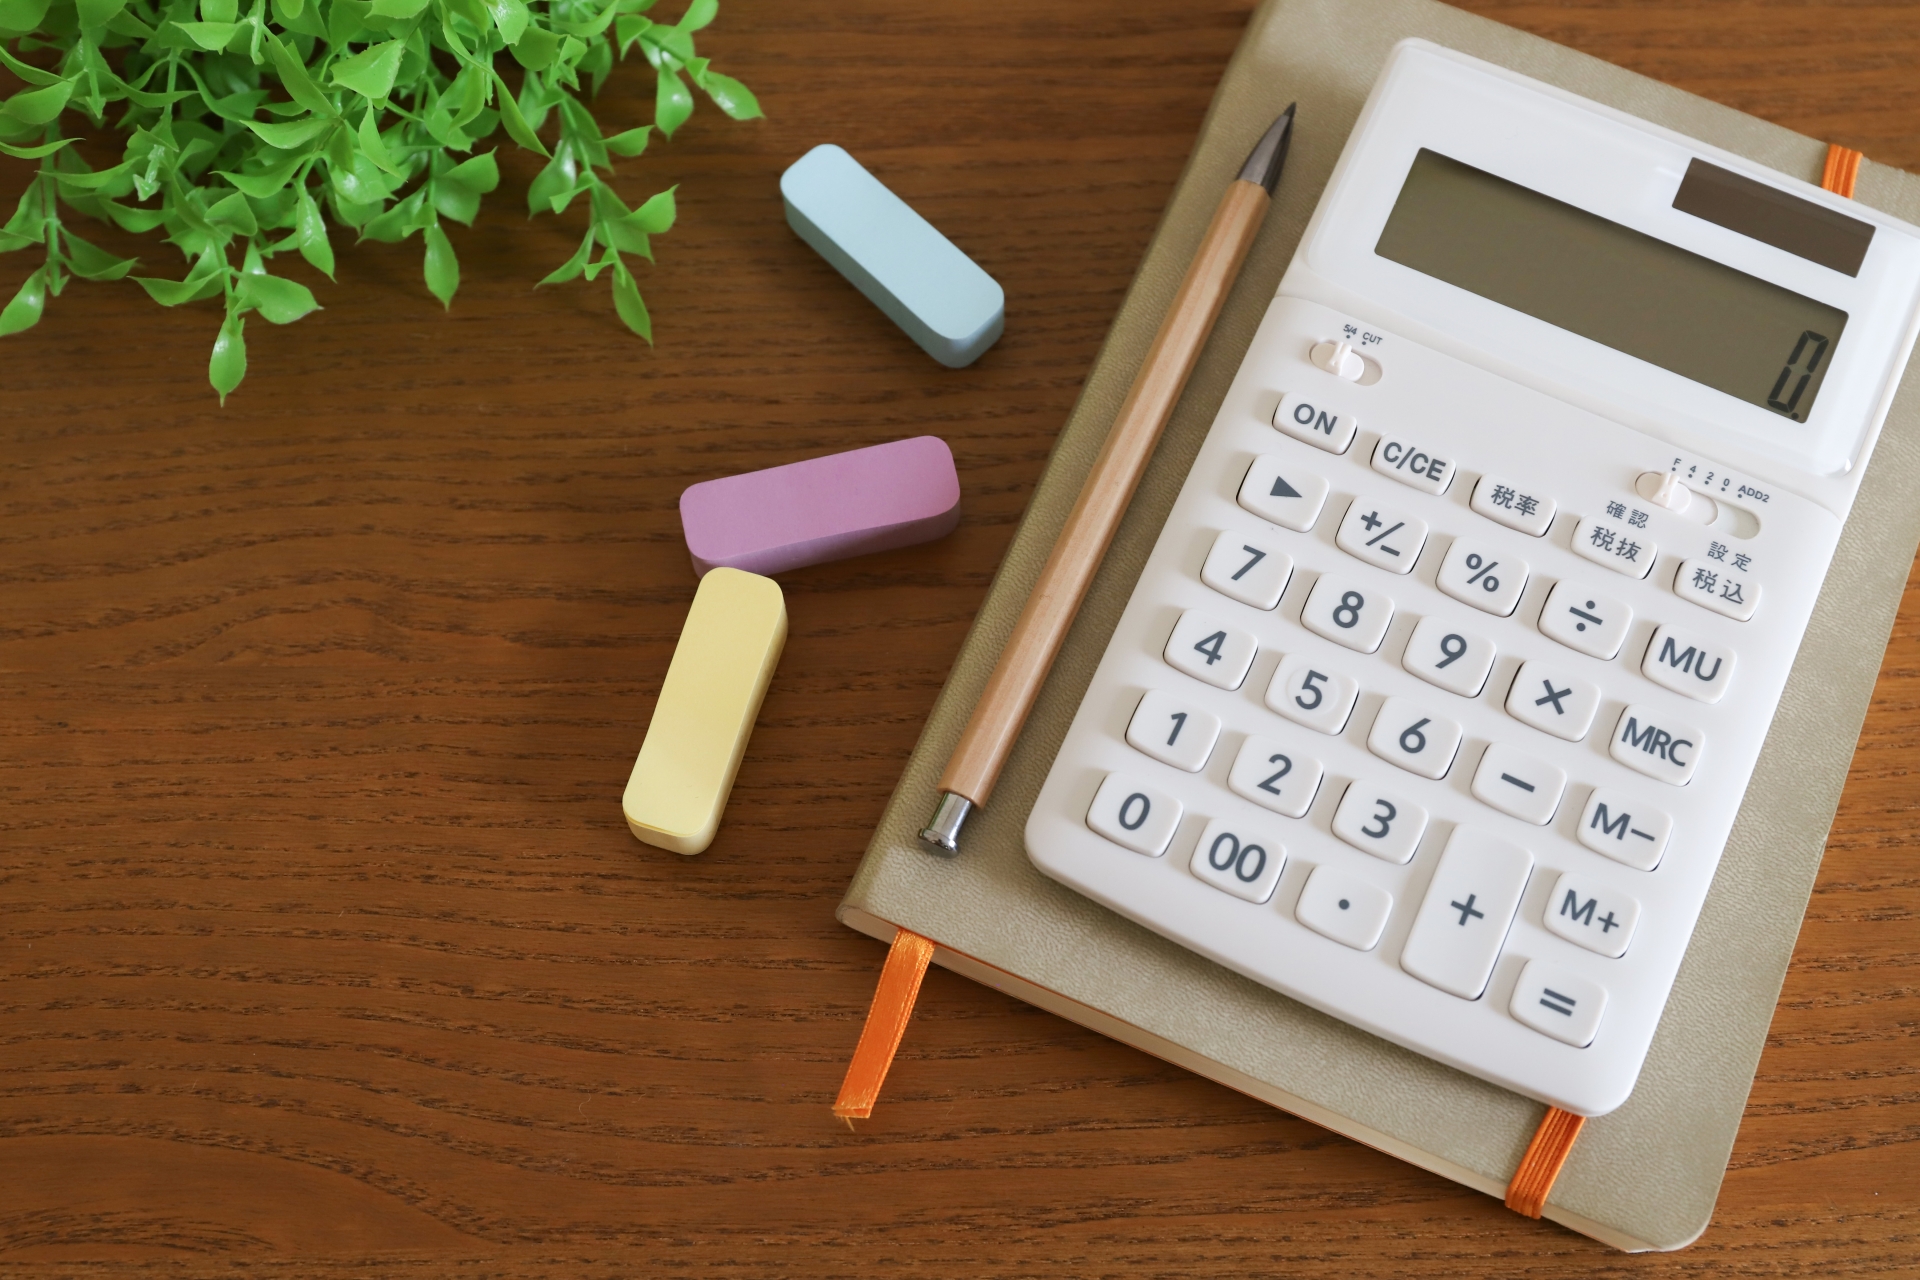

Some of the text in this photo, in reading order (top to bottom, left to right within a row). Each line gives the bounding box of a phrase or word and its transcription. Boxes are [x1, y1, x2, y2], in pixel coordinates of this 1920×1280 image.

[1343, 324, 1383, 345] 5/4 CUT
[1294, 404, 1338, 435] ON
[1383, 441, 1447, 482] C/CE
[1673, 457, 1682, 466] F
[1689, 465, 1697, 474] 4
[1706, 471, 1715, 481] 2
[1738, 485, 1770, 503] ADD2
[1491, 485, 1539, 516] 税率
[1606, 500, 1649, 529] 確認
[1231, 545, 1266, 581] 7
[1590, 525, 1642, 563] 税抜
[1707, 541, 1752, 572] 設定
[1466, 554, 1499, 592] %
[1692, 567, 1745, 605] 税込
[1333, 591, 1364, 628] 8
[1194, 631, 1227, 665] 4
[1435, 634, 1467, 669] 9
[1659, 637, 1722, 681] MU
[1295, 670, 1328, 710] 5
[1167, 712, 1187, 746] 1
[1399, 718, 1431, 754] 6
[1622, 717, 1693, 767] MRC
[1257, 754, 1292, 795] 2
[1119, 793, 1151, 831] 0
[1361, 799, 1396, 839] 3
[1209, 832, 1267, 884] 00
[1560, 889, 1619, 933] M+
